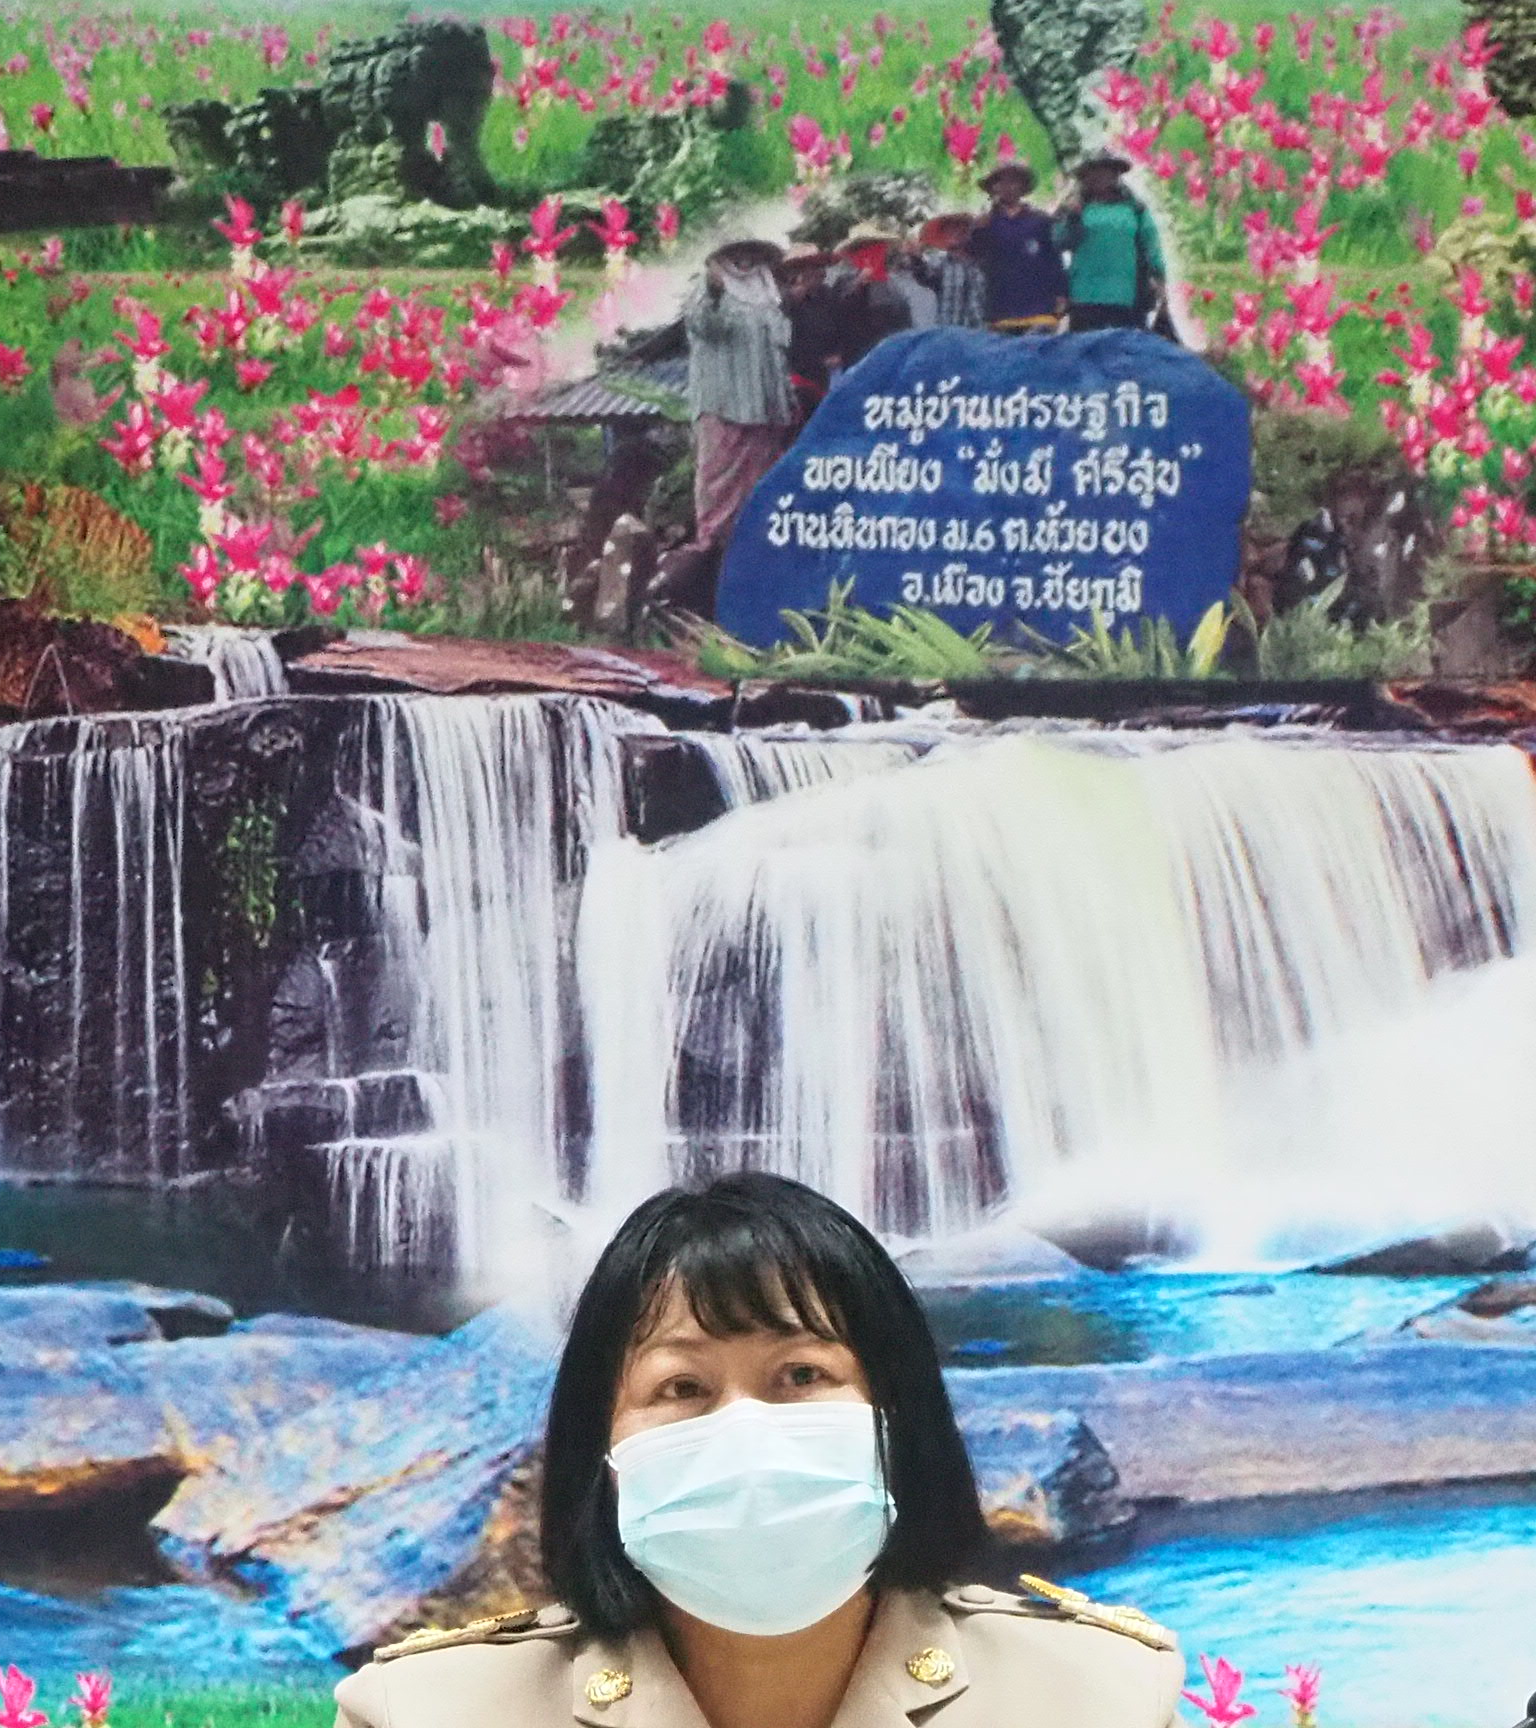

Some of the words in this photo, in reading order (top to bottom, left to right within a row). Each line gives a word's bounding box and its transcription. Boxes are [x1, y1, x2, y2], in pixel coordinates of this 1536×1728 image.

[803, 441, 943, 494] พอเพียง
[767, 493, 938, 552] บ้านหินกอง
[942, 518, 997, 552] ม.6
[901, 561, 1006, 608] อ.เมือง
[1011, 560, 1144, 629] จ.ชัยภูมิ
